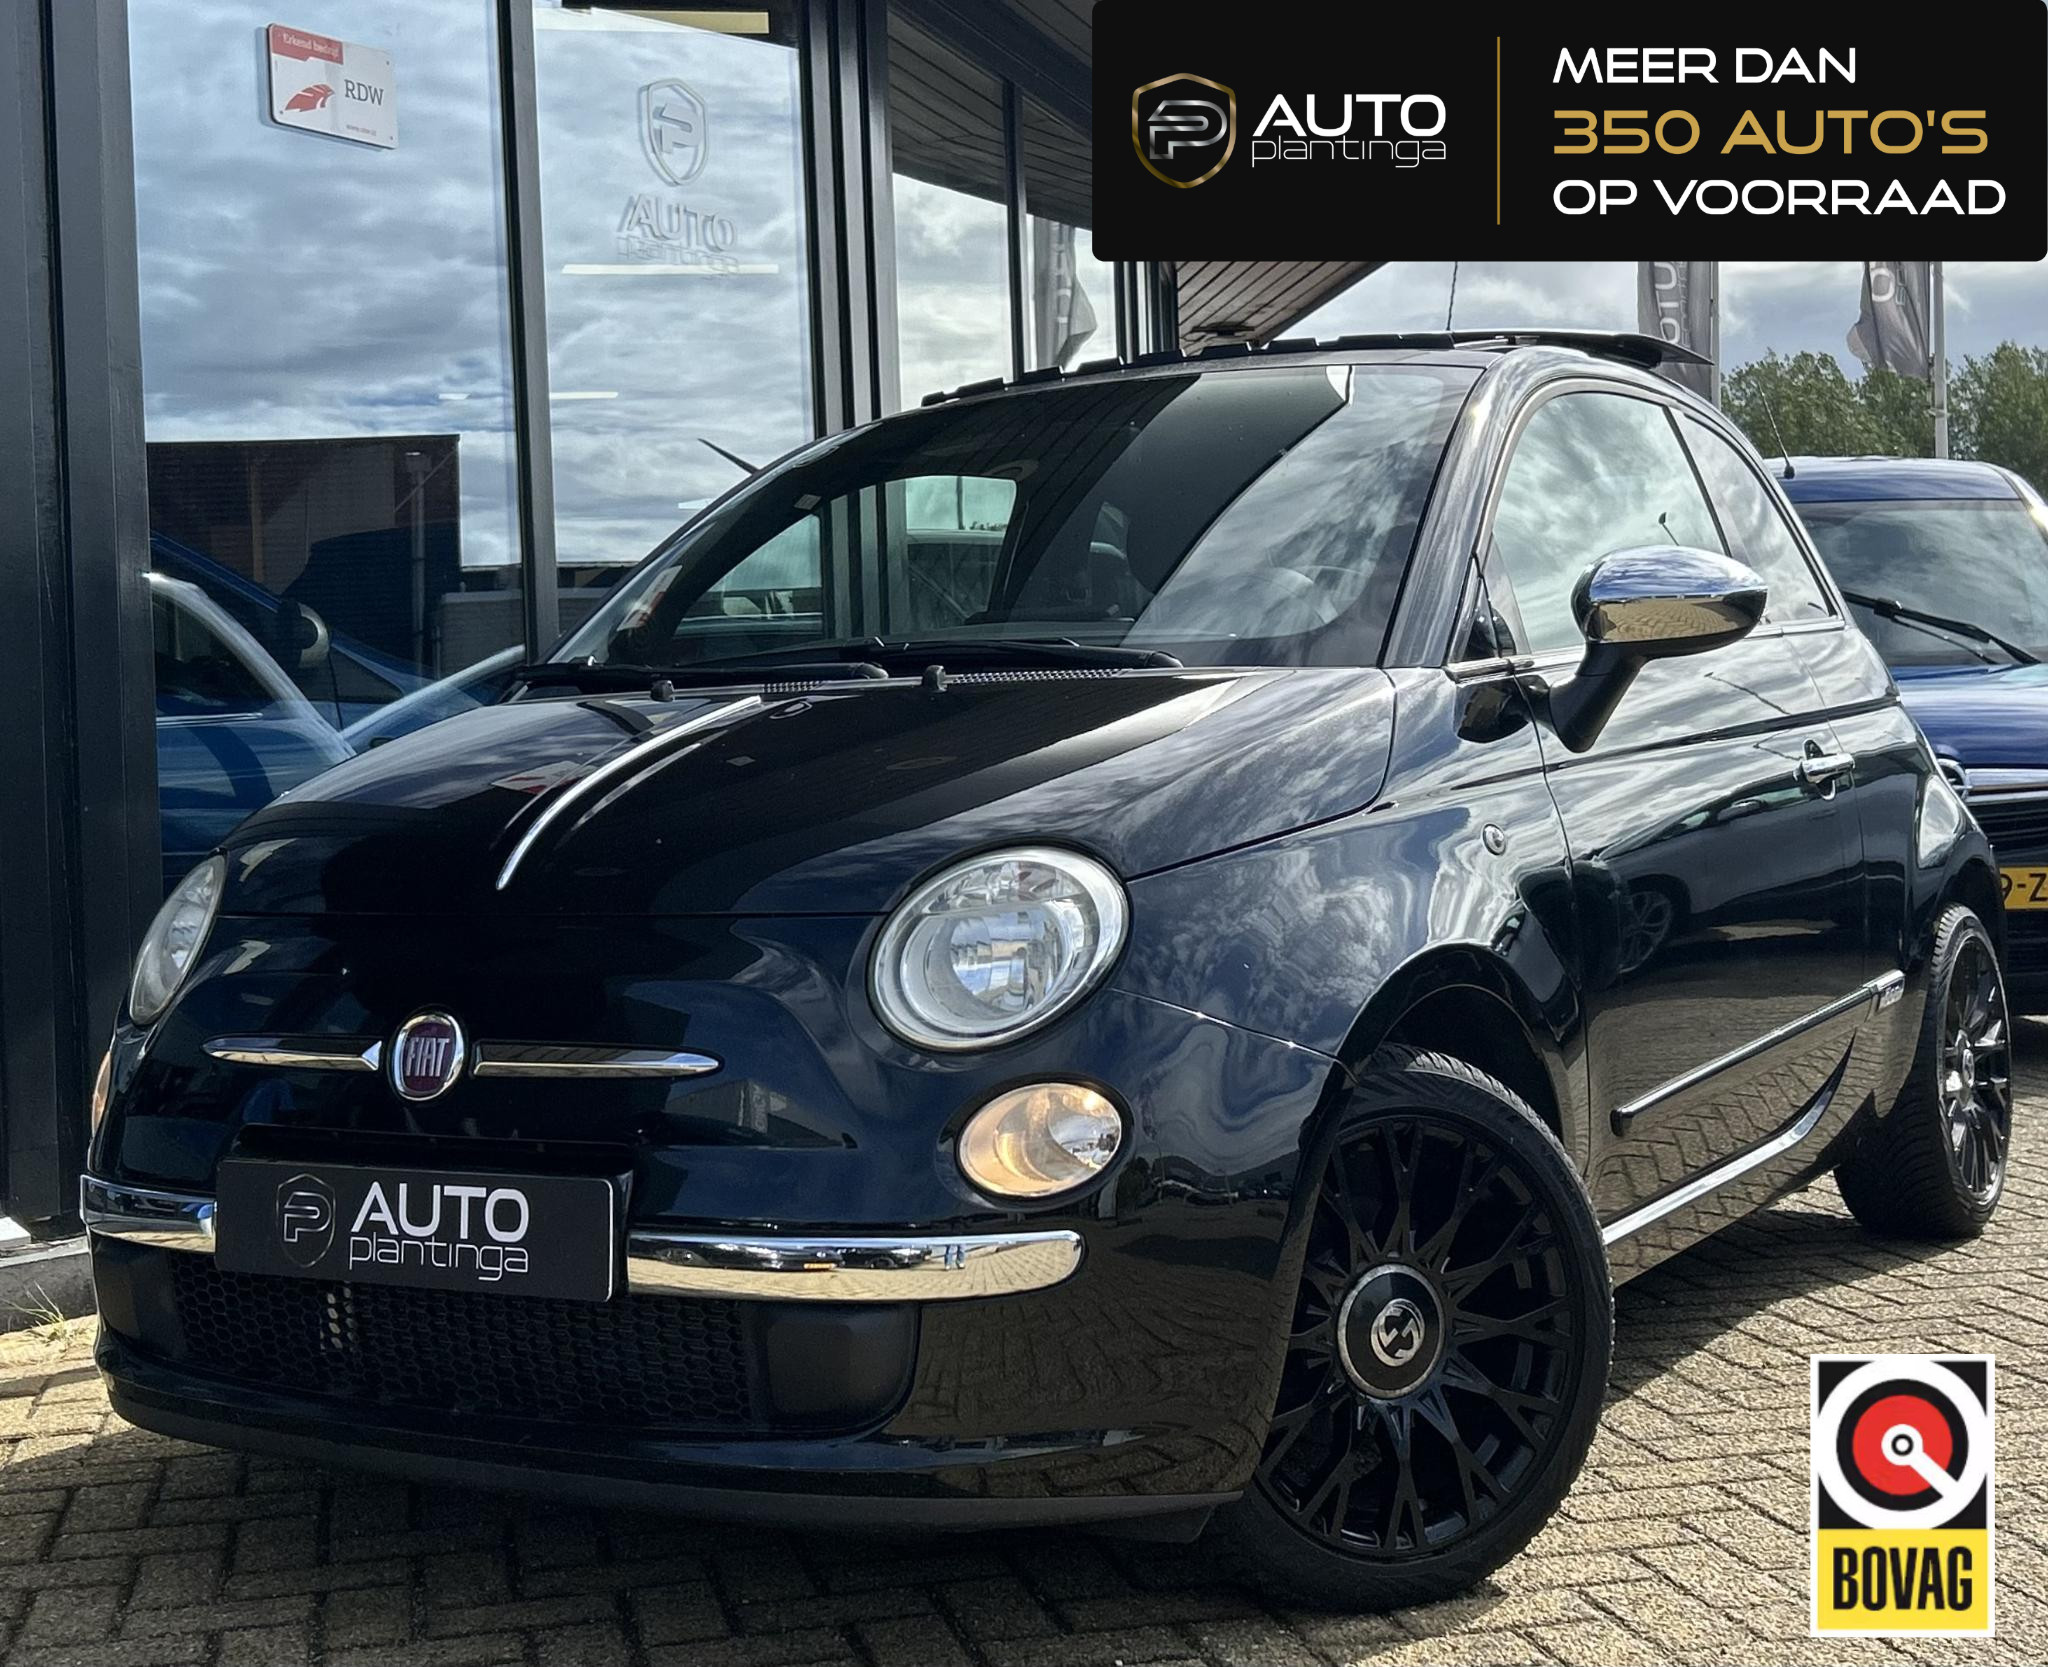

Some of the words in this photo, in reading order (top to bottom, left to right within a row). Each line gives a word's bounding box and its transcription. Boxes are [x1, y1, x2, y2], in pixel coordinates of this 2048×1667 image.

[344, 79, 384, 106] RDW
[617, 194, 736, 252] AUTO
[406, 1037, 450, 1077] FIAT
[351, 1181, 530, 1243] AUTO
[350, 1232, 529, 1281] plantinga
